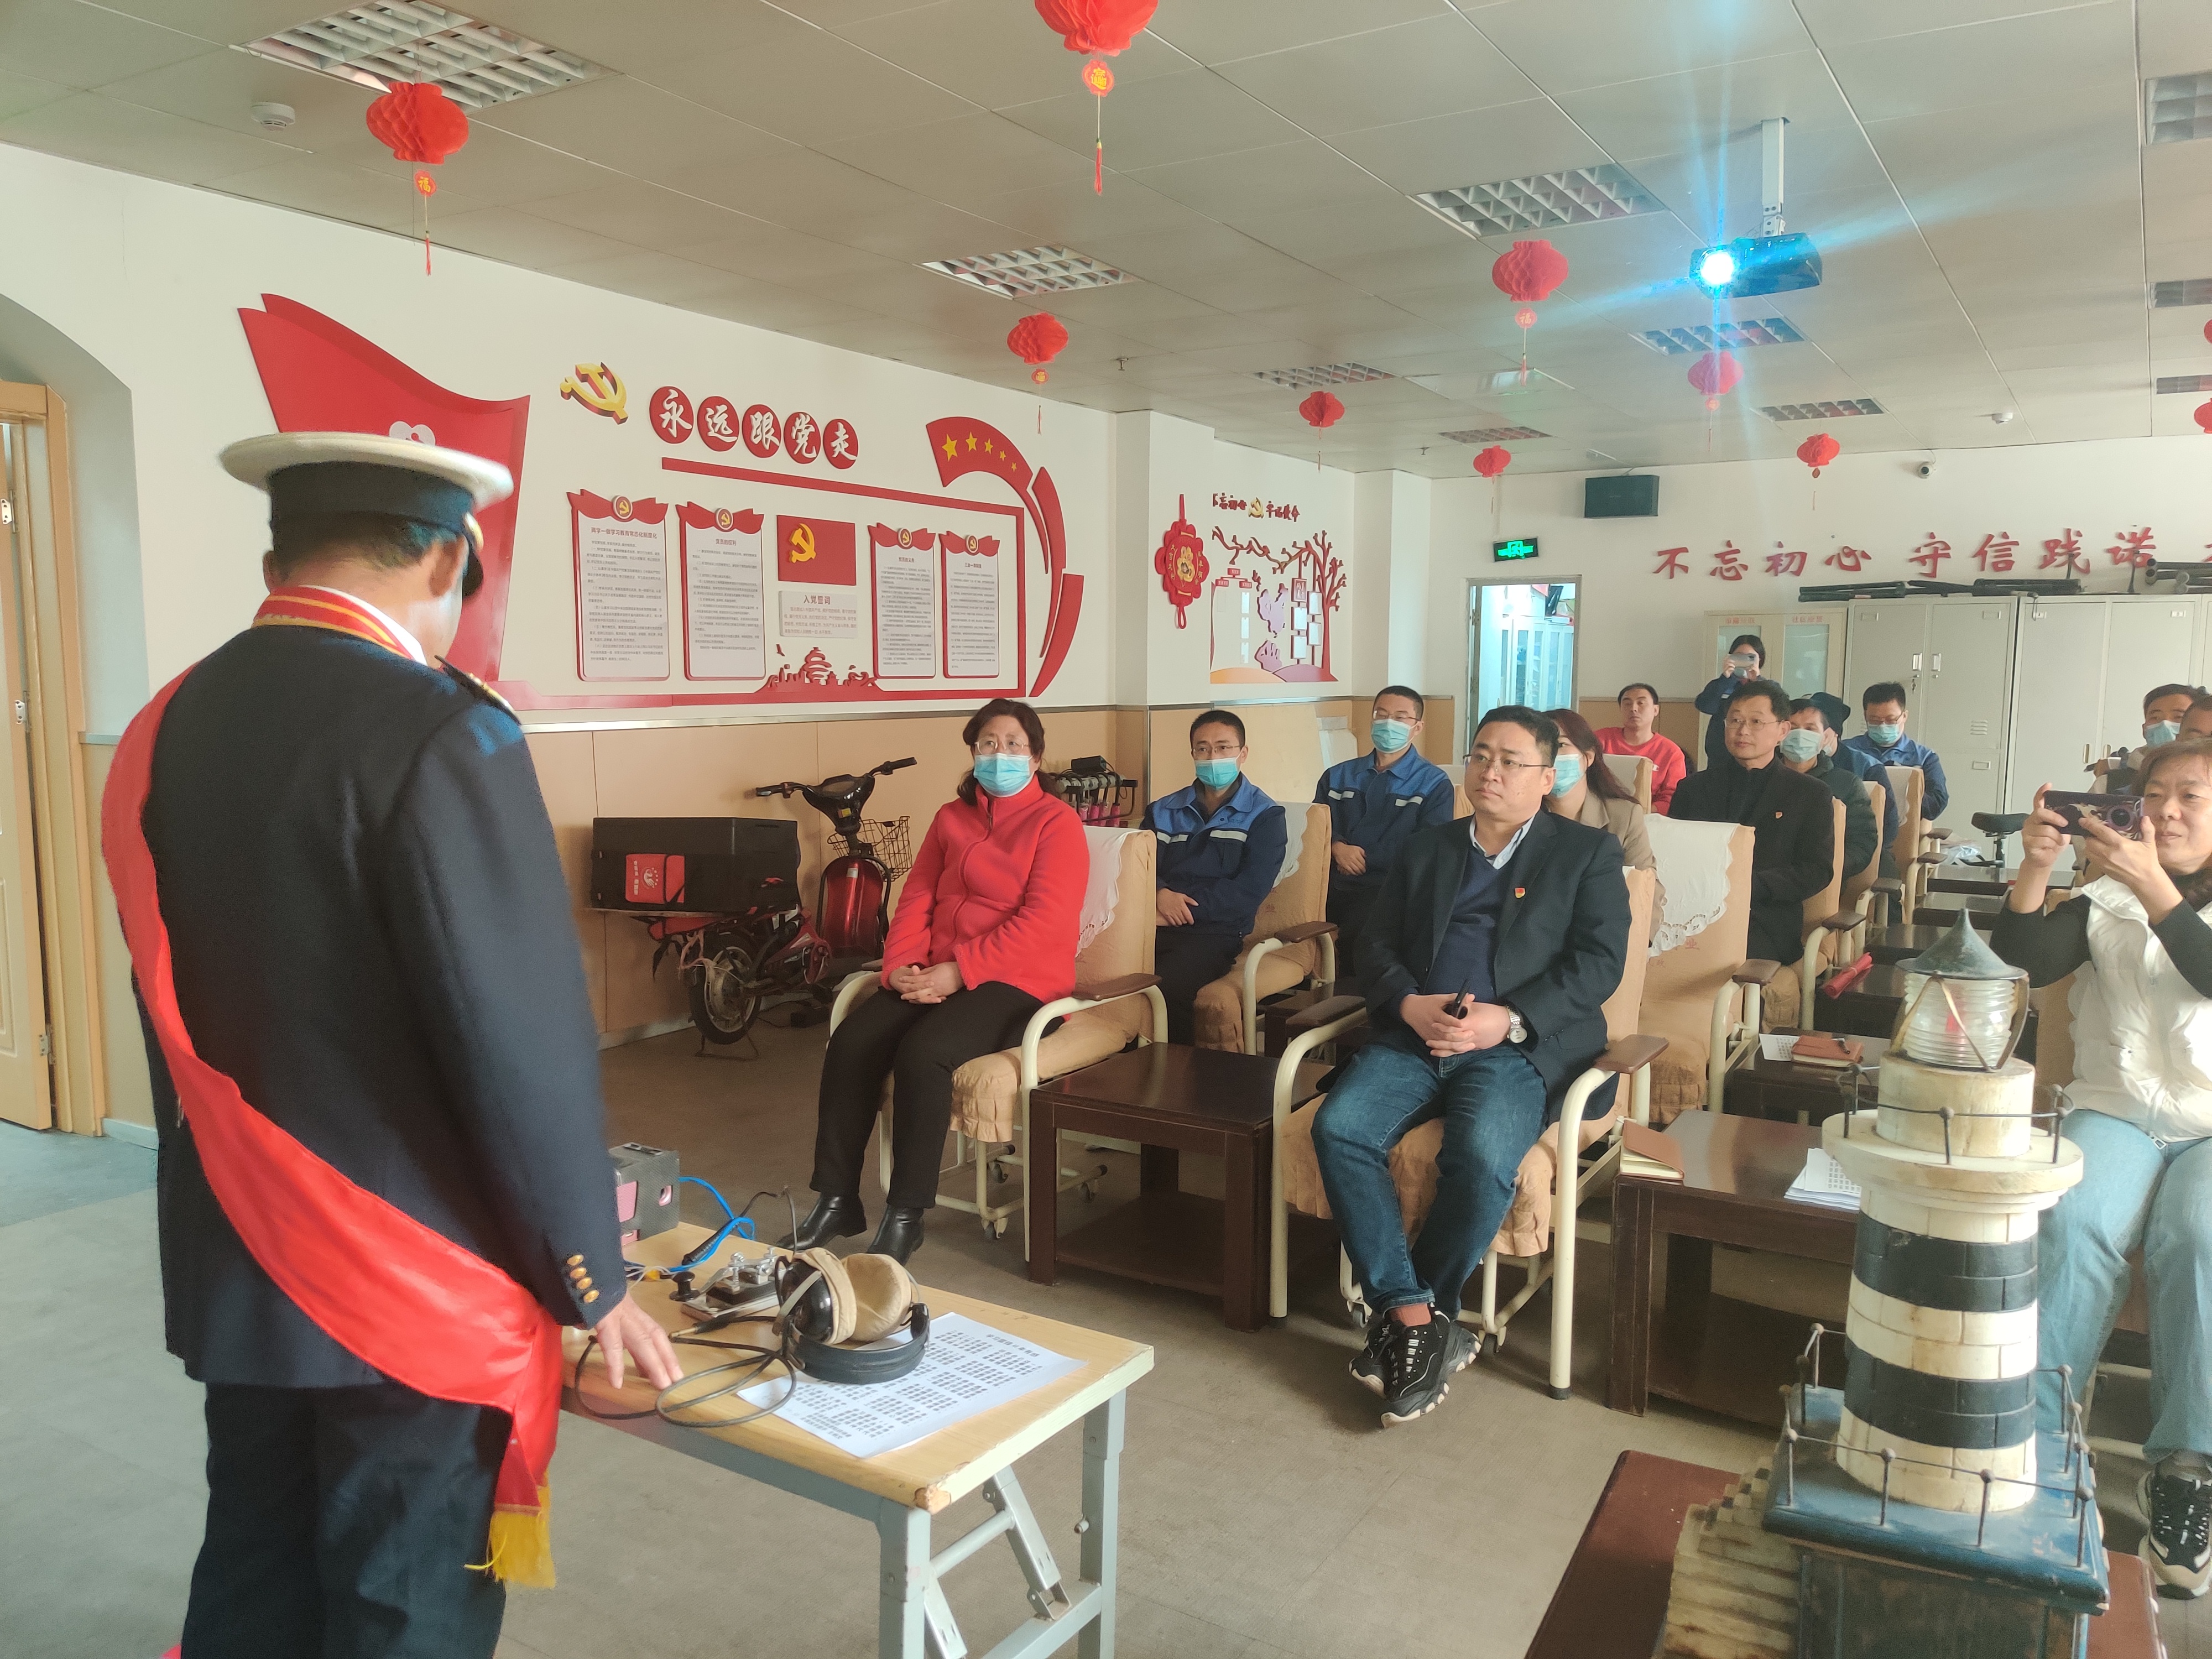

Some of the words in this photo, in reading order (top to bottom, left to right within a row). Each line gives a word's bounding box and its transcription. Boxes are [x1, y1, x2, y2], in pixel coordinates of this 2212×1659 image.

[419, 177, 431, 192] 福
[659, 388, 858, 460] 永远跟党走
[1653, 540, 1872, 581] 不忘初心
[1909, 527, 2157, 577] 守信践诺
[804, 594, 831, 605] 入党誓词
